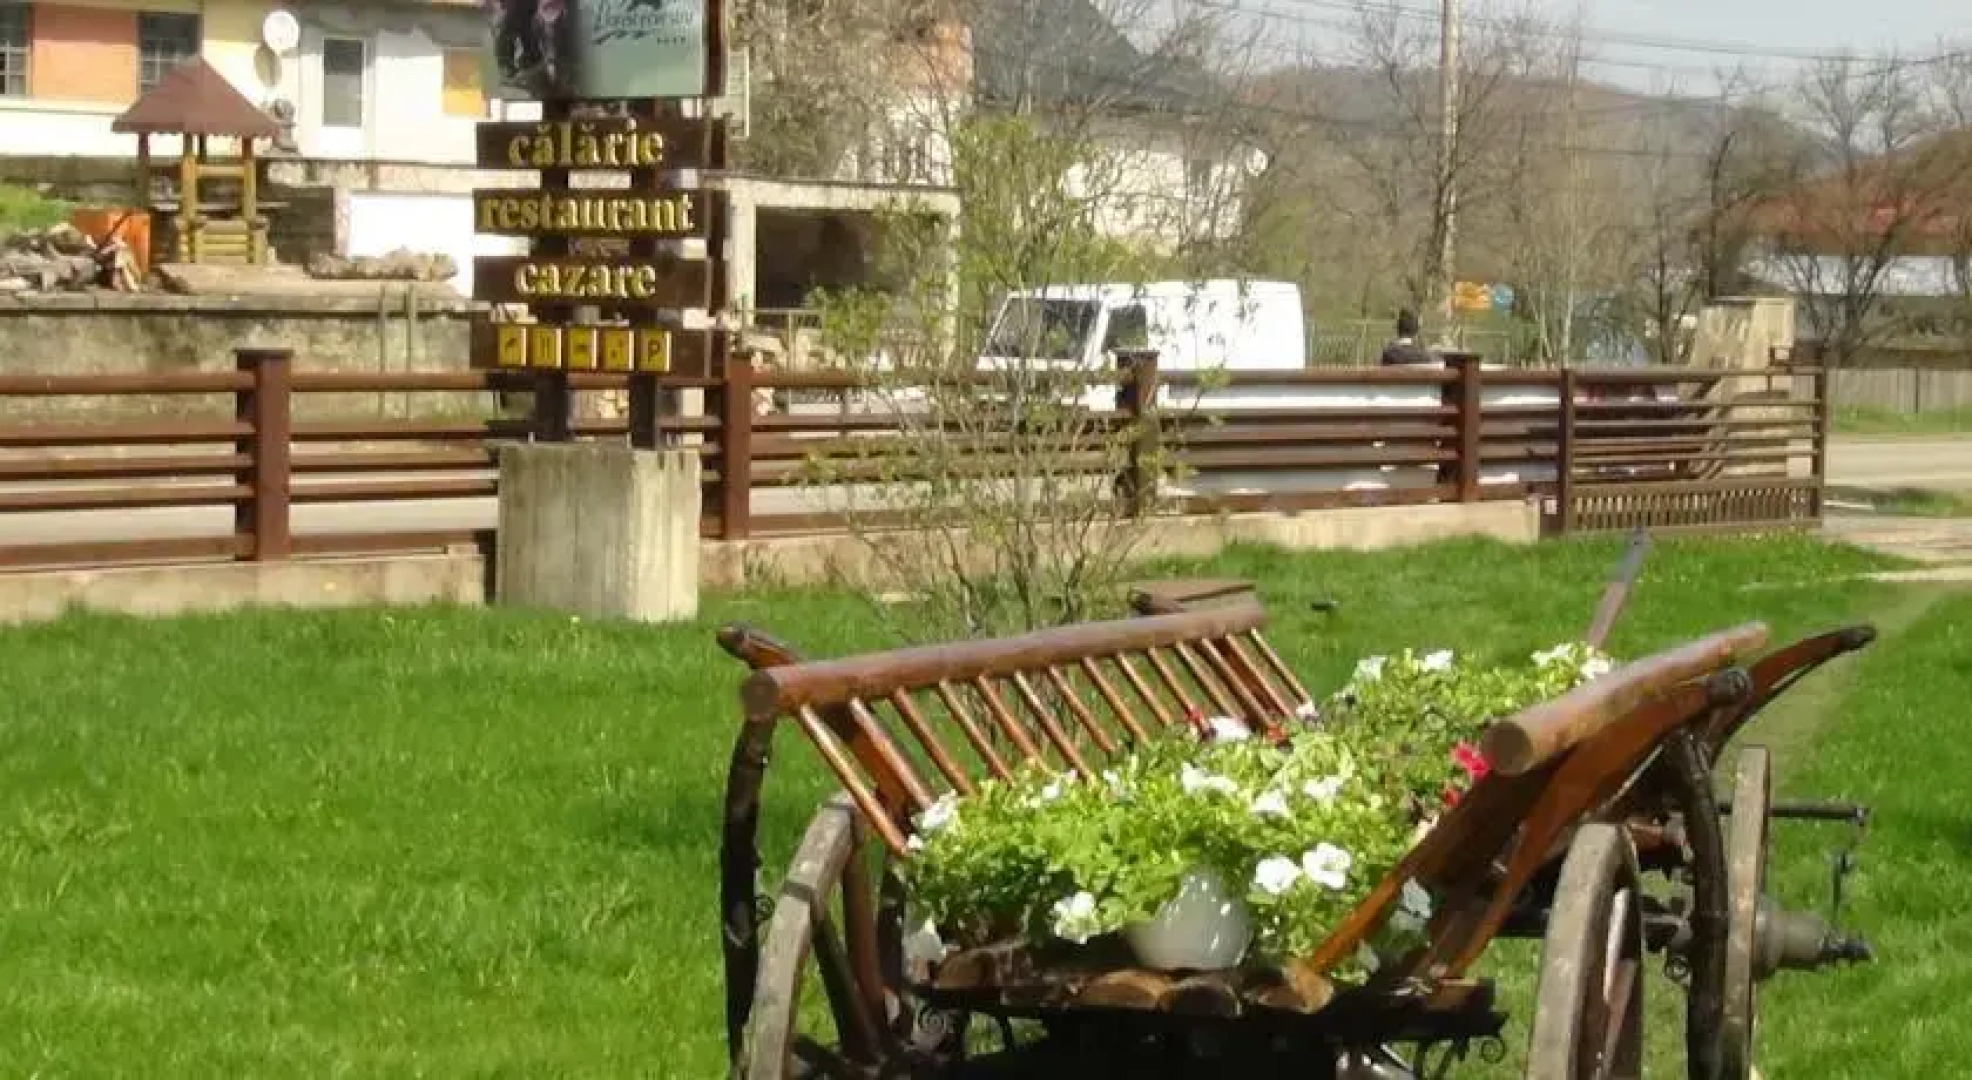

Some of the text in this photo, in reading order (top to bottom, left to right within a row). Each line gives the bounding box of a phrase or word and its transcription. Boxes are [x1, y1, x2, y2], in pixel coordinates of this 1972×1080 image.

[508, 118, 664, 166] călărie
[479, 193, 694, 230] restaurant
[514, 262, 656, 298] cazare
[647, 339, 661, 358] P
